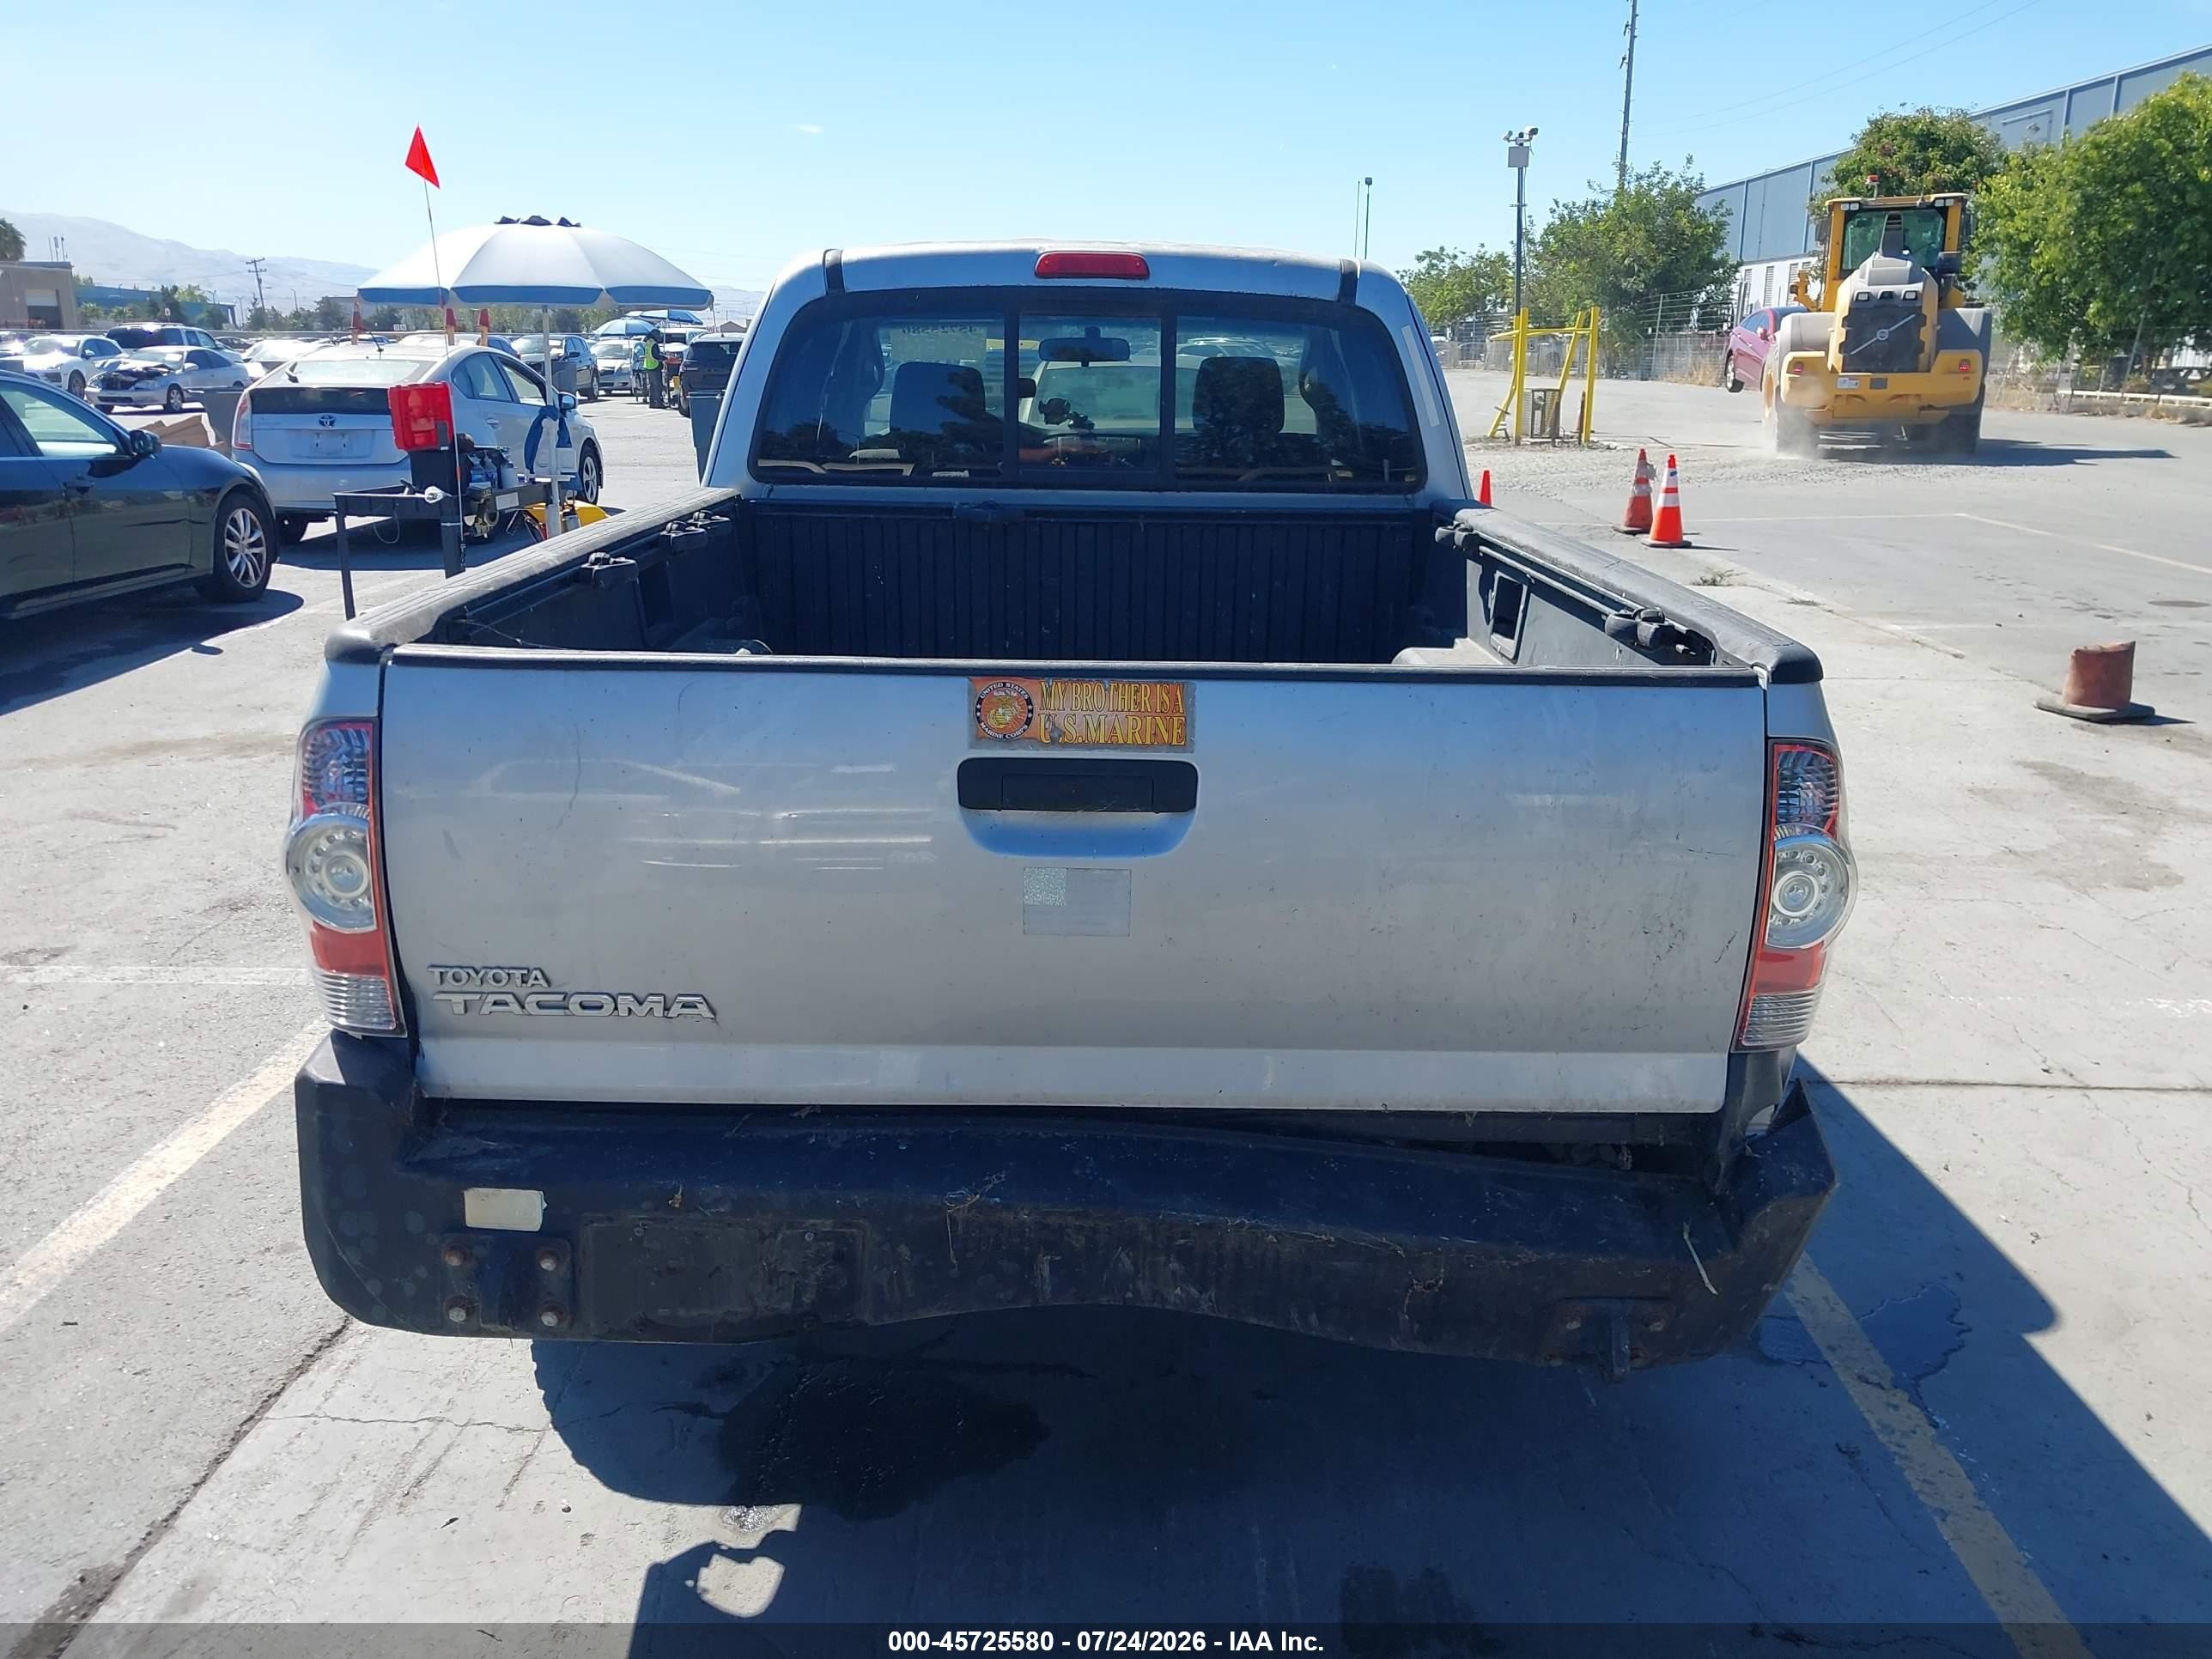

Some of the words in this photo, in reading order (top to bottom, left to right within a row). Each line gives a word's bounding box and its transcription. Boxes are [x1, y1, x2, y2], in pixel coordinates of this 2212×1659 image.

[980, 682, 1004, 699] UNITED
[1006, 683, 1030, 700] STATES
[1039, 680, 1067, 711] MY
[1071, 682, 1152, 713] BROTHER
[1154, 684, 1170, 714] IS
[1172, 684, 1185, 714] A
[981, 721, 1004, 739] MARINE
[1005, 724, 1029, 739] CORPS
[427, 964, 551, 988] TOYOTA
[432, 991, 716, 1019] TACOMA
